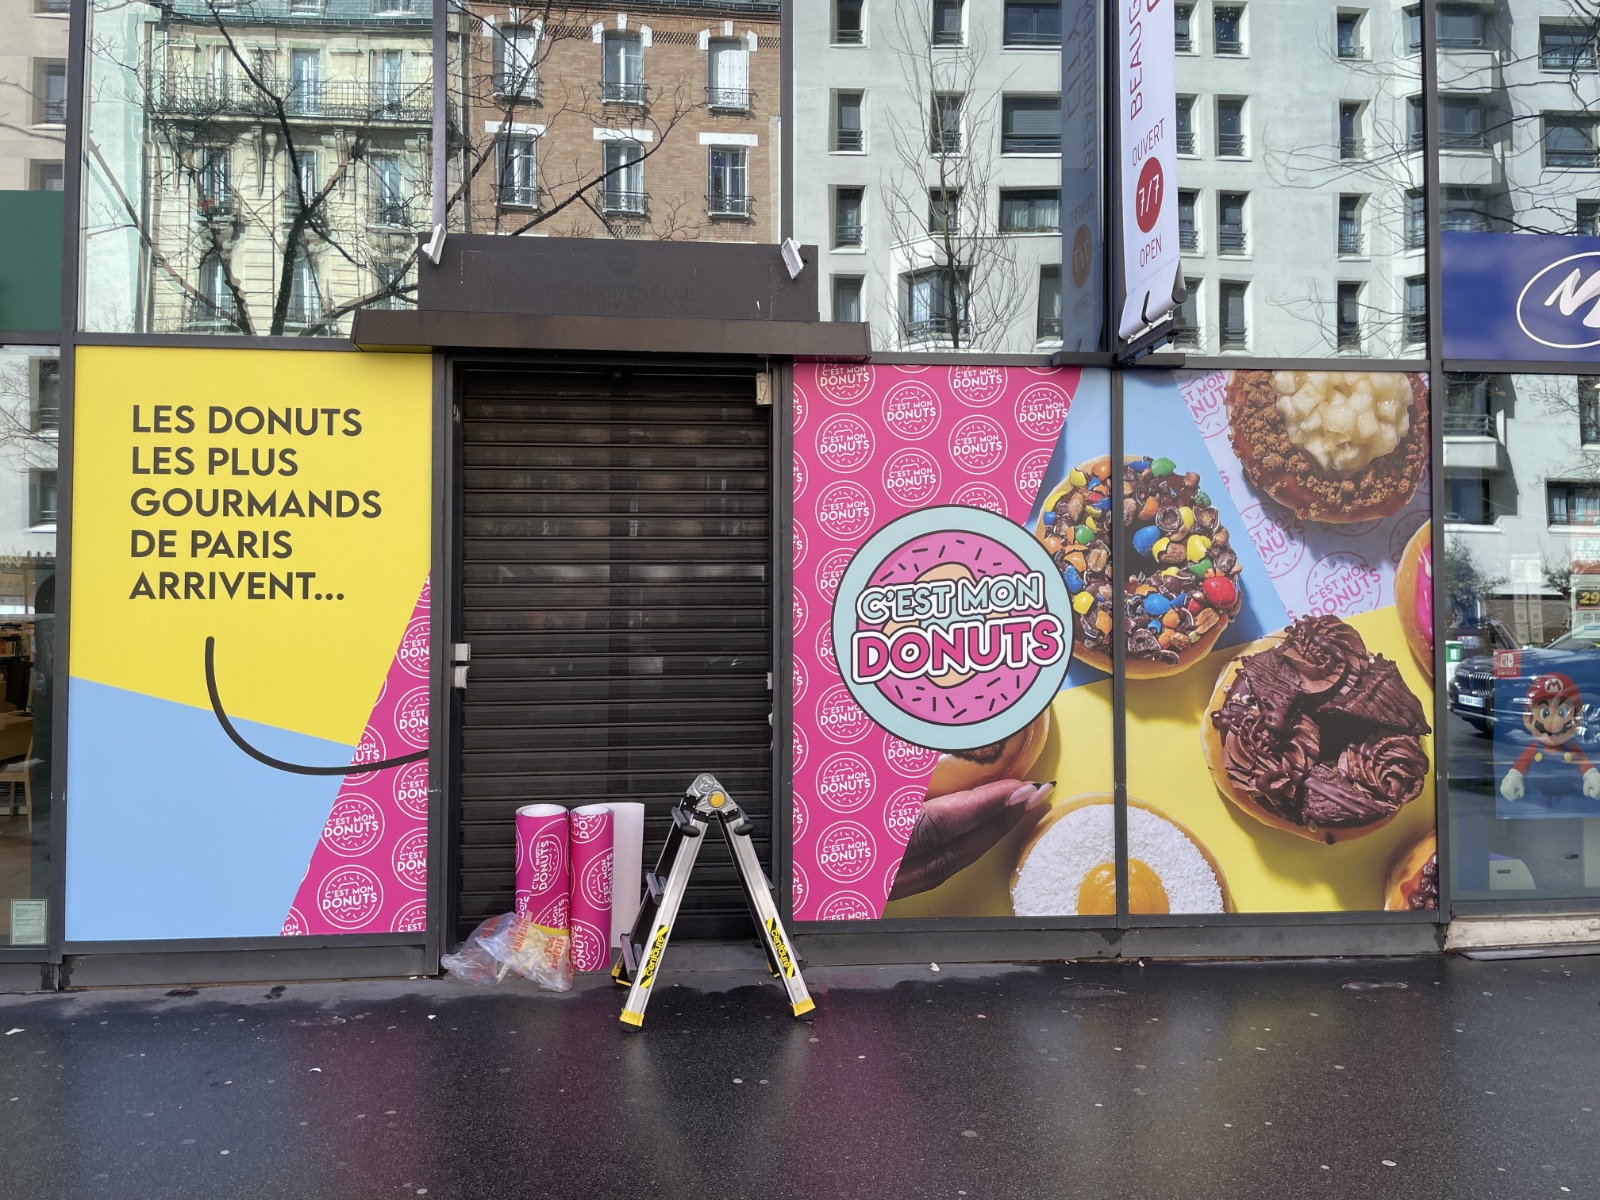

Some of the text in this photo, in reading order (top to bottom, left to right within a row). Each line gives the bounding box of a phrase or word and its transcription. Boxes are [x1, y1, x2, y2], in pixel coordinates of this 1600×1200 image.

[1132, 117, 1165, 167] OUVERT
[1138, 173, 1160, 217] 7/7
[1140, 234, 1162, 268] OPEN
[822, 366, 866, 376] C'EST MON
[955, 370, 976, 378] C'EST
[820, 372, 870, 387] DONUTS
[954, 374, 1002, 389] DONUTS
[1196, 371, 1226, 396] MON
[889, 402, 910, 411] C'EST
[1021, 404, 1042, 412] C'EST
[132, 404, 362, 437] LES DONUTS
[887, 407, 936, 422] DONUTS
[1020, 408, 1067, 423] DONUTS
[822, 433, 866, 444] C'EST MON
[955, 437, 976, 445] C'EST
[820, 440, 870, 454] DONUTS
[954, 441, 1002, 456] DONUTS
[132, 446, 299, 476] LES PLUS
[887, 474, 936, 489] DONUTS
[889, 470, 910, 478] C'EST
[1022, 470, 1043, 479] C'EST
[130, 488, 382, 518] GOURMANDS
[822, 500, 866, 511] C'EST MON
[820, 507, 870, 522] DONUTS
[131, 530, 293, 558] DE PARIS
[129, 571, 344, 600] ARRIVENT...
[1308, 580, 1338, 606] C'EST
[1342, 560, 1370, 584] MON
[858, 573, 1044, 622] C'EST MON
[1310, 568, 1381, 617] DONUTS
[402, 638, 426, 648] C'EST
[854, 617, 1062, 682] DONUTS
[401, 709, 425, 718] C'EST
[822, 706, 845, 714] C'EST
[400, 780, 424, 790] C'EST
[820, 778, 871, 794] DONUTS
[822, 774, 845, 783] C'EST
[326, 813, 375, 826] C'EST MON
[890, 808, 912, 817] C'EST
[324, 821, 379, 838] DONUTS
[823, 841, 868, 853] C'EST MON
[399, 851, 423, 860] C'EST
[821, 848, 871, 864] DONUTS
[539, 840, 550, 890] DONUTS
[325, 885, 374, 898] C'EST MON
[322, 892, 378, 910] DONUTS
[282, 923, 299, 932] ON
[398, 923, 422, 932] C'EST
[574, 925, 586, 972] ONUTS
[646, 935, 664, 976] centaure
[771, 929, 790, 968] centaure
